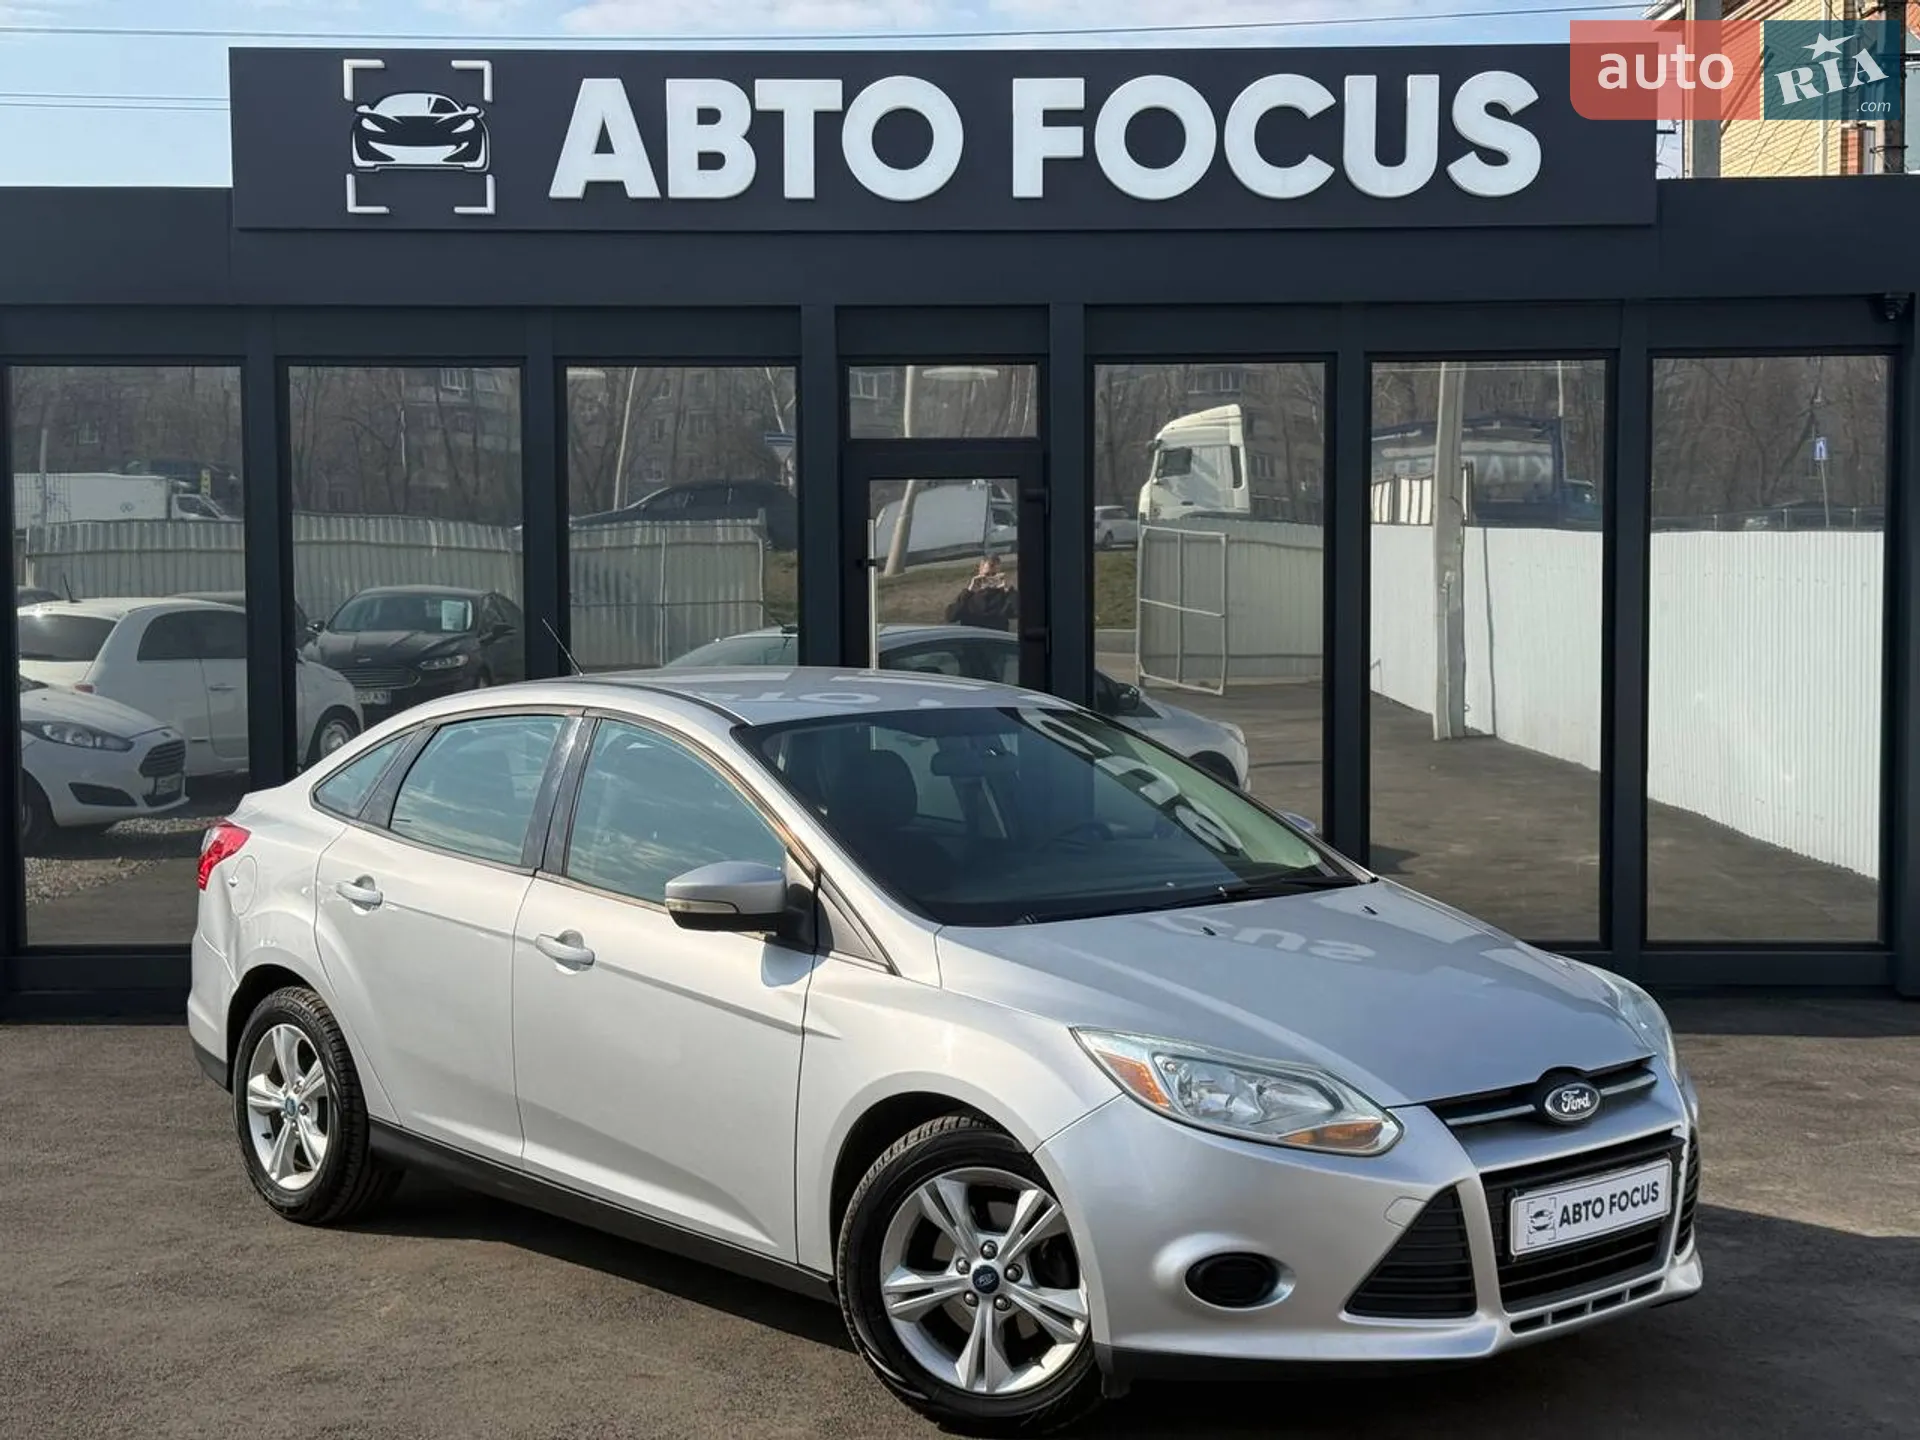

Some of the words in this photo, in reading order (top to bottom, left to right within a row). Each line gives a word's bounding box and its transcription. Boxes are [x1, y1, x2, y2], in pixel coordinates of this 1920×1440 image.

[548, 75, 964, 201] АВТО
[1012, 70, 1542, 200] FOCUS
[1560, 1088, 1591, 1113] Ford
[1559, 1198, 1605, 1228] АВТО
[1608, 1181, 1660, 1214] FOCUS
